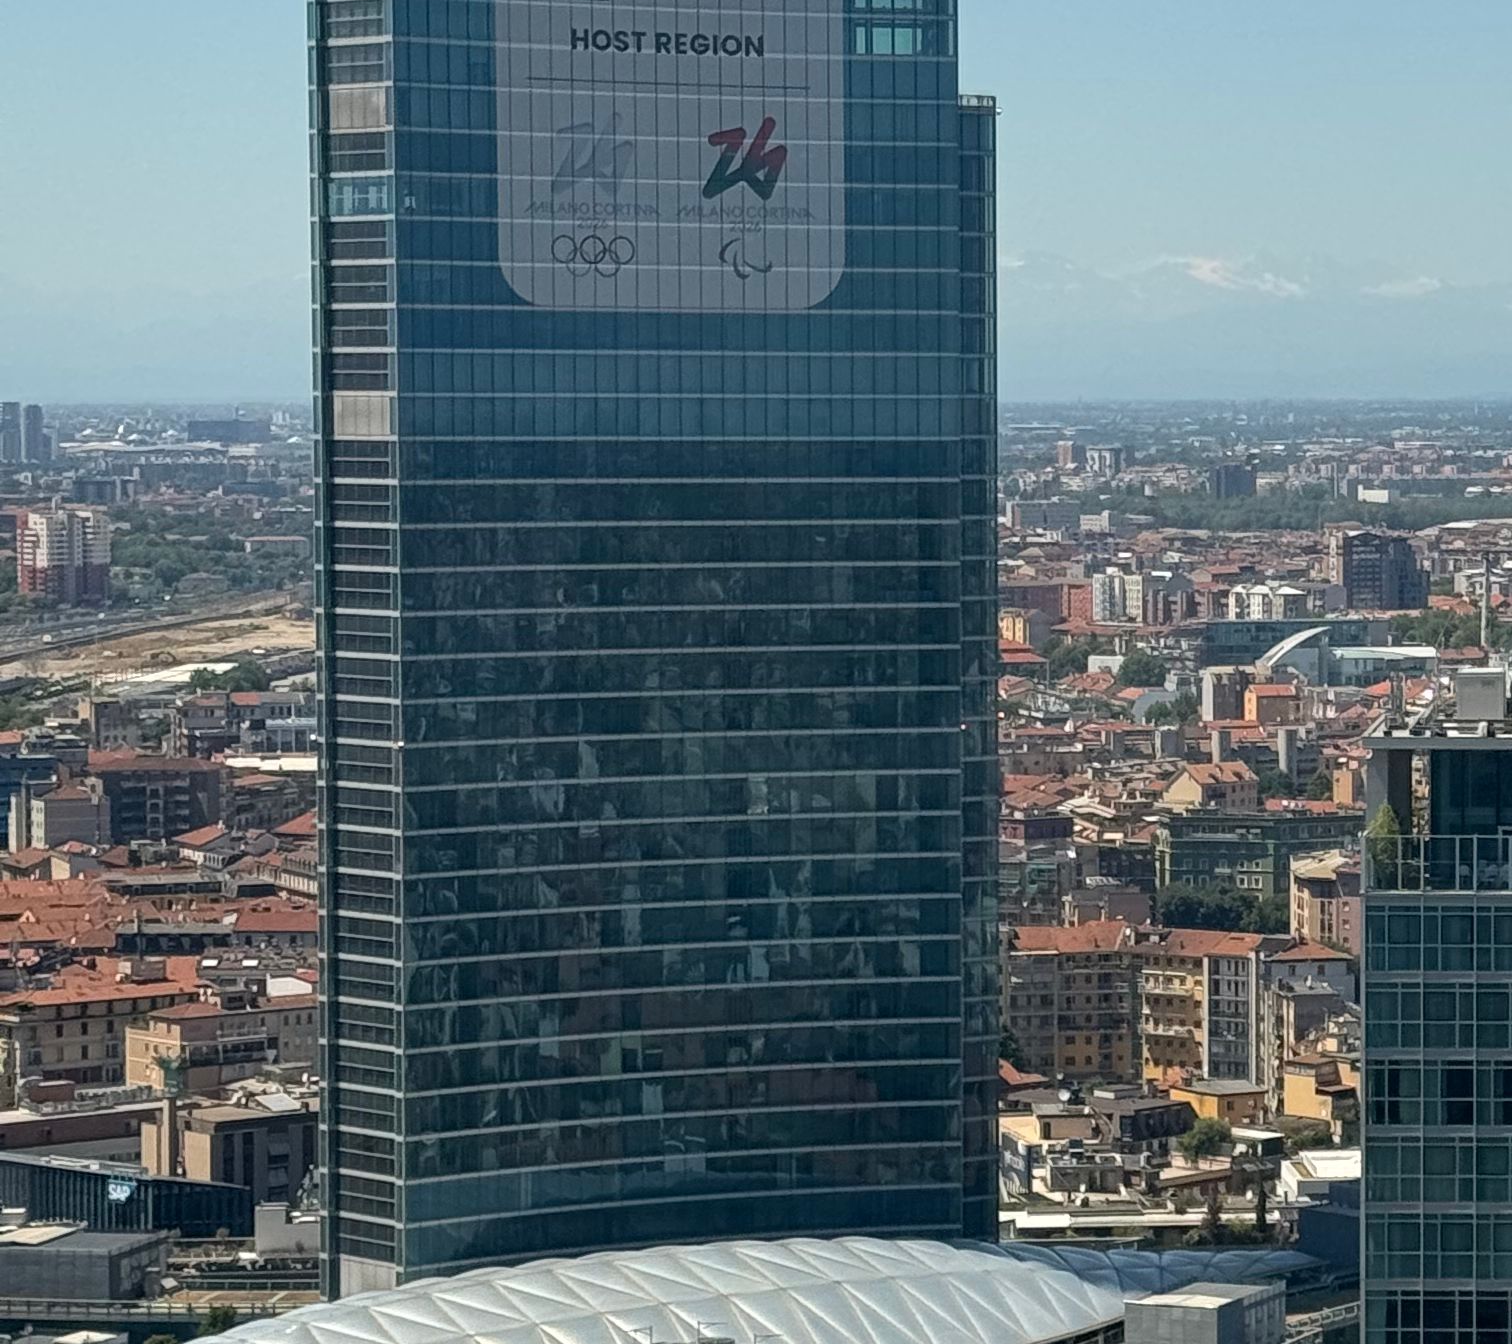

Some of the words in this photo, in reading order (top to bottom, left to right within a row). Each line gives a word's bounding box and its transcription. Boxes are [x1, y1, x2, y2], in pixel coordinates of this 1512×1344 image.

[570, 27, 647, 53] HOST
[654, 32, 764, 57] REGION
[524, 201, 589, 216] MILANO
[595, 202, 661, 217] CORTINA
[678, 203, 744, 219] MILANO
[746, 205, 815, 221] CORTINA
